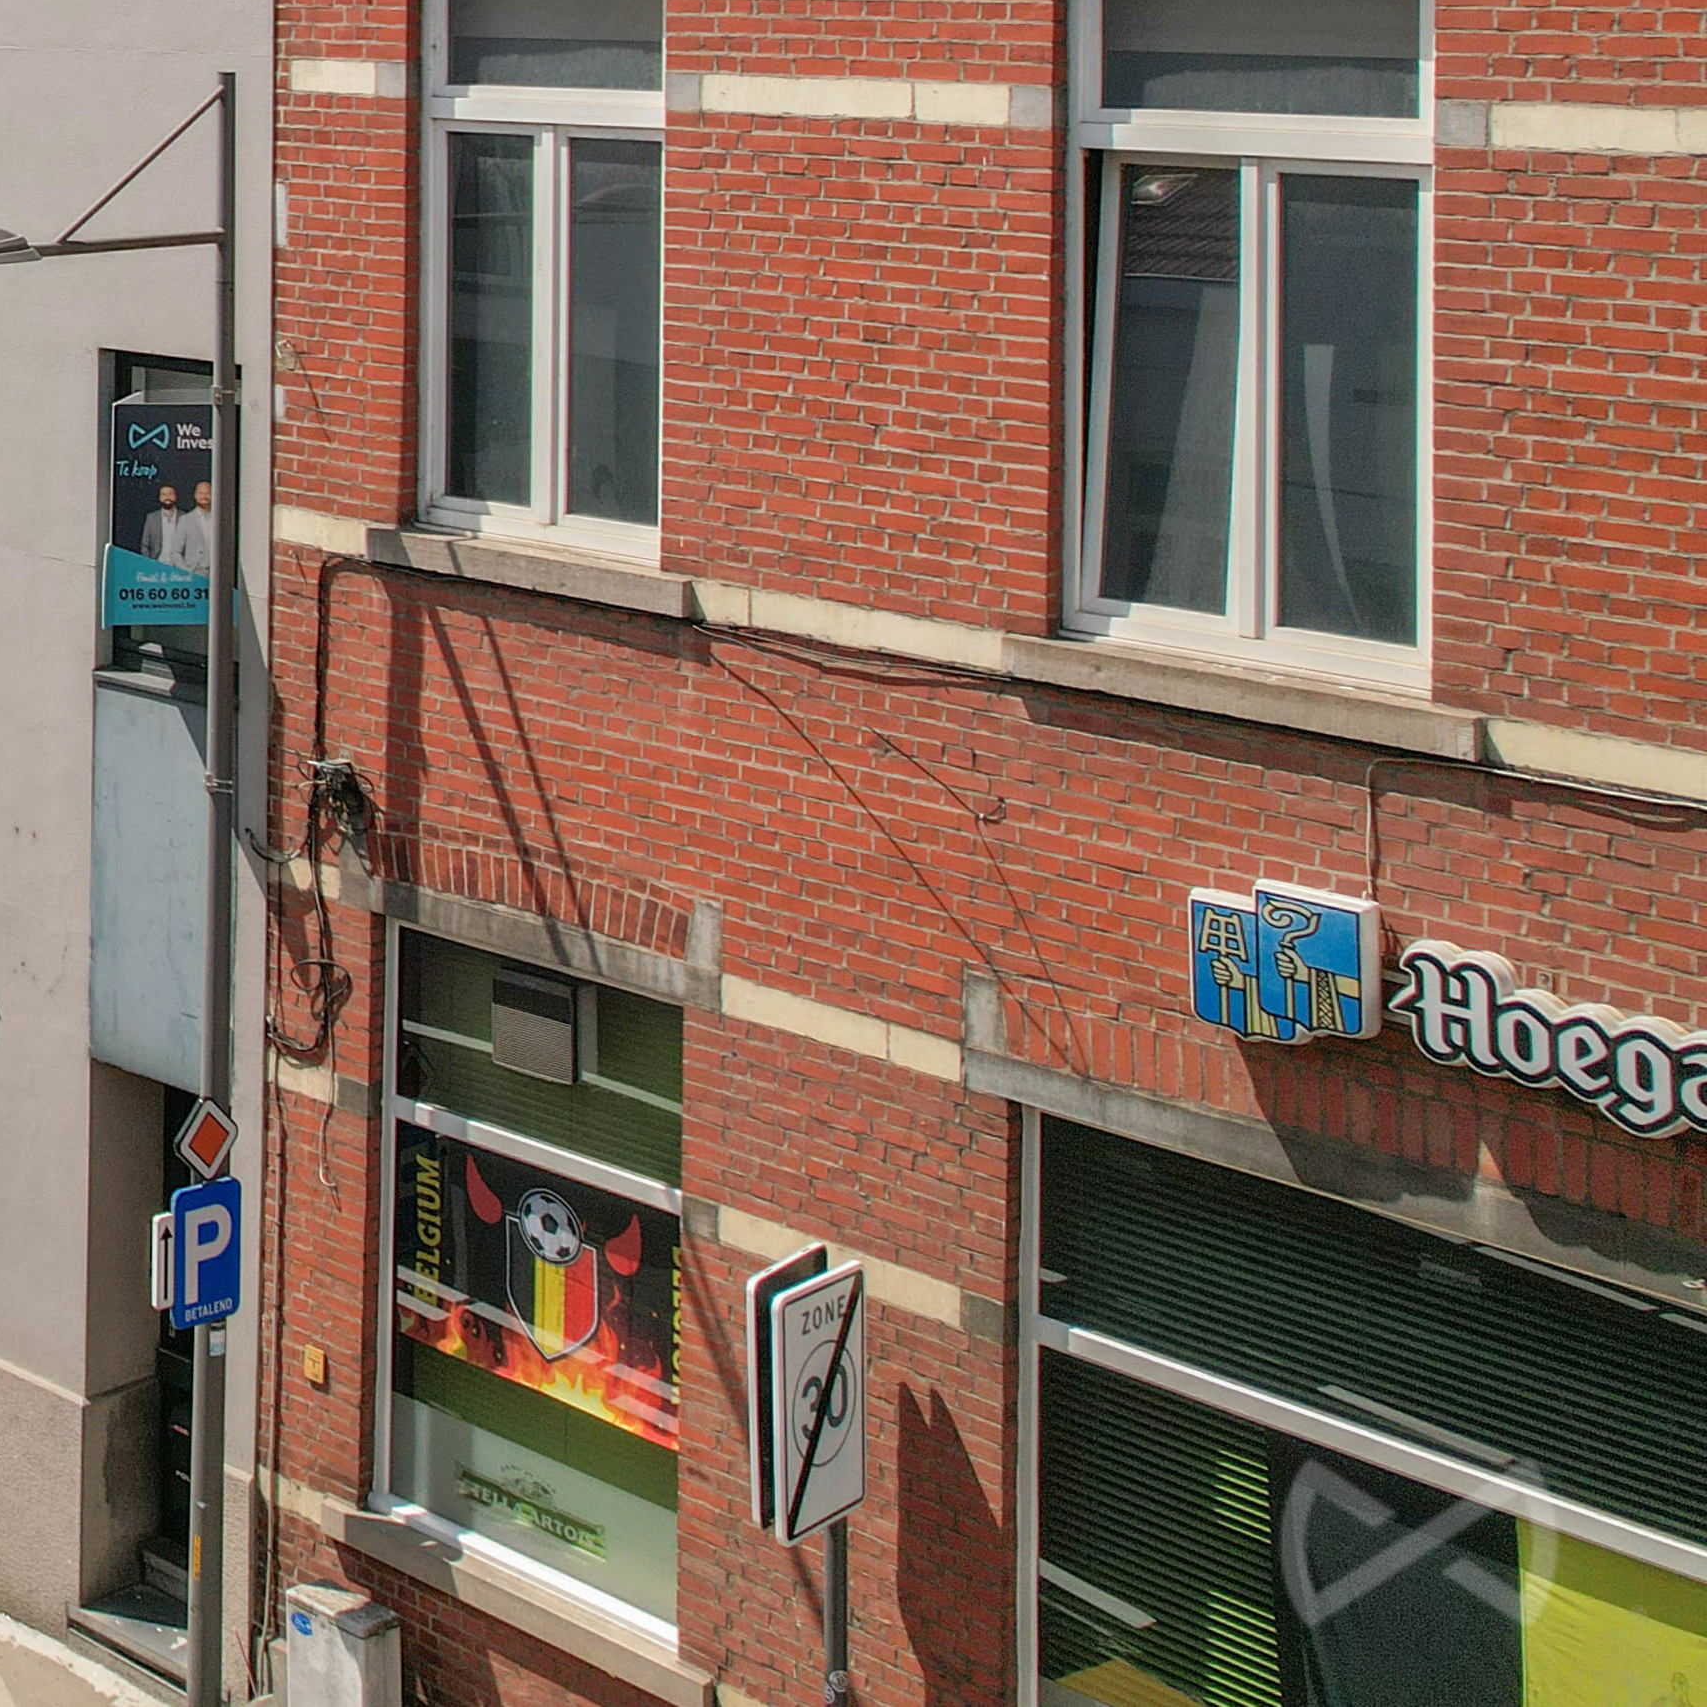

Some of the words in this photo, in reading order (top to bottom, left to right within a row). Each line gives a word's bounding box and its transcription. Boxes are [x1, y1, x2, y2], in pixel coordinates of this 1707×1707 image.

[176, 423, 202, 437] We
[176, 437, 214, 450] Inves
[116, 459, 130, 477] Te
[131, 459, 159, 481] koop
[119, 588, 145, 601] 016
[148, 588, 167, 601] 60
[171, 588, 190, 600] 60
[194, 588, 209, 600] 31
[184, 1204, 232, 1306] P
[184, 1297, 233, 1322] BETALEND
[802, 1295, 847, 1336] ZONE
[801, 1361, 848, 1442] 30
